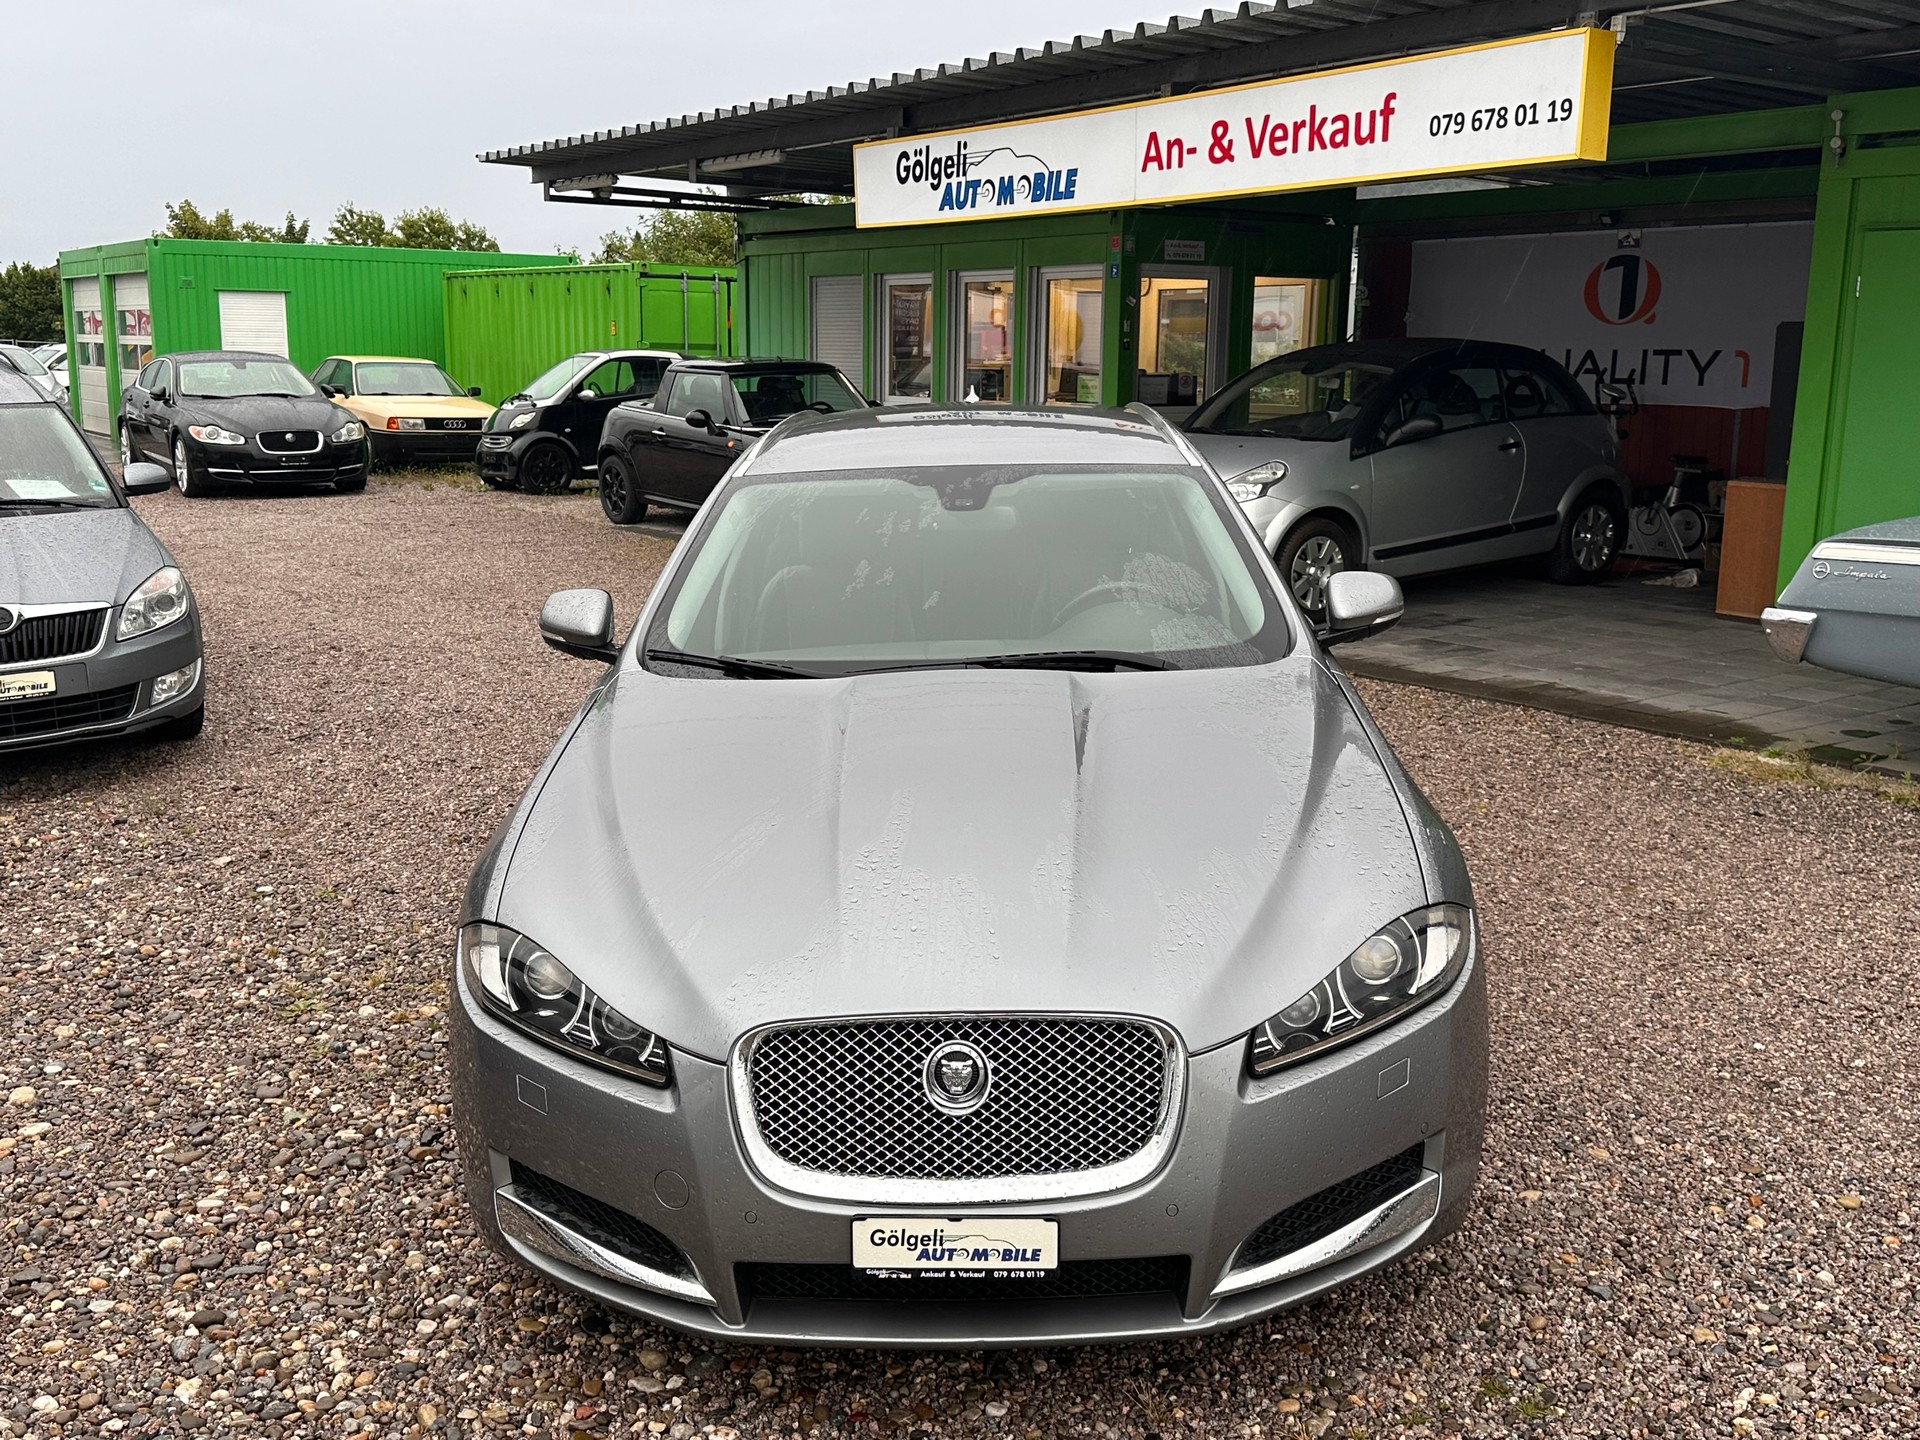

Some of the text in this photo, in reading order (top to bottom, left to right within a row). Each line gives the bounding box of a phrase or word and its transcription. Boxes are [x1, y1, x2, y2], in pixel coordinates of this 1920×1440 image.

[1141, 92, 1397, 173] An- & Verkauf
[1428, 97, 1573, 137] 079 678 01 19
[896, 140, 968, 191] Gölgeli
[1735, 350, 1750, 388] 1
[1834, 566, 1891, 581] Impala
[870, 1228, 944, 1251] Gölgeli
